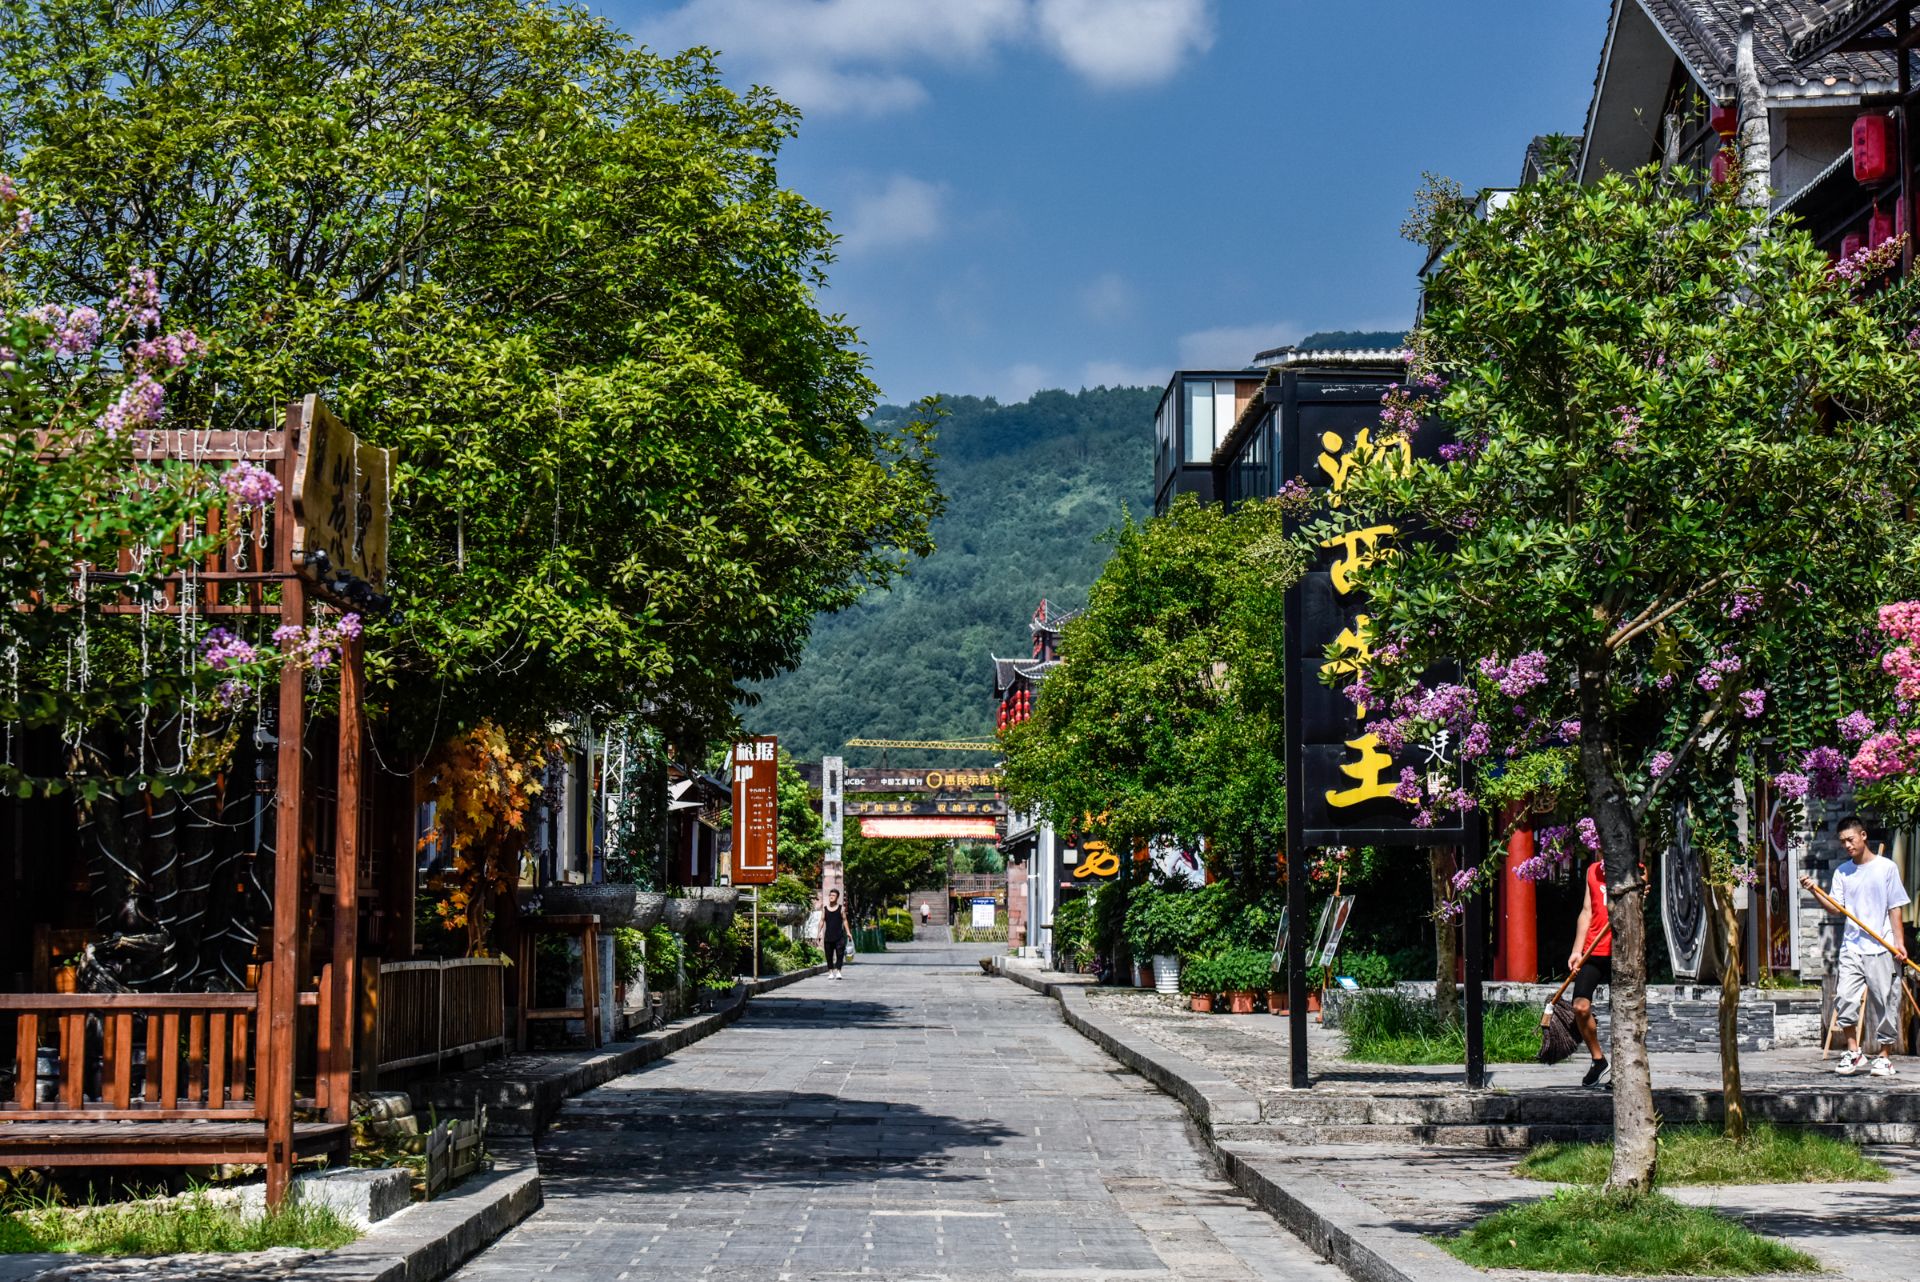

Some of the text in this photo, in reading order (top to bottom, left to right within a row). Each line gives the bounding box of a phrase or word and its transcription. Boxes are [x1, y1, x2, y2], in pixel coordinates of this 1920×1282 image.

[880, 778, 923, 786] 中国工商银行
